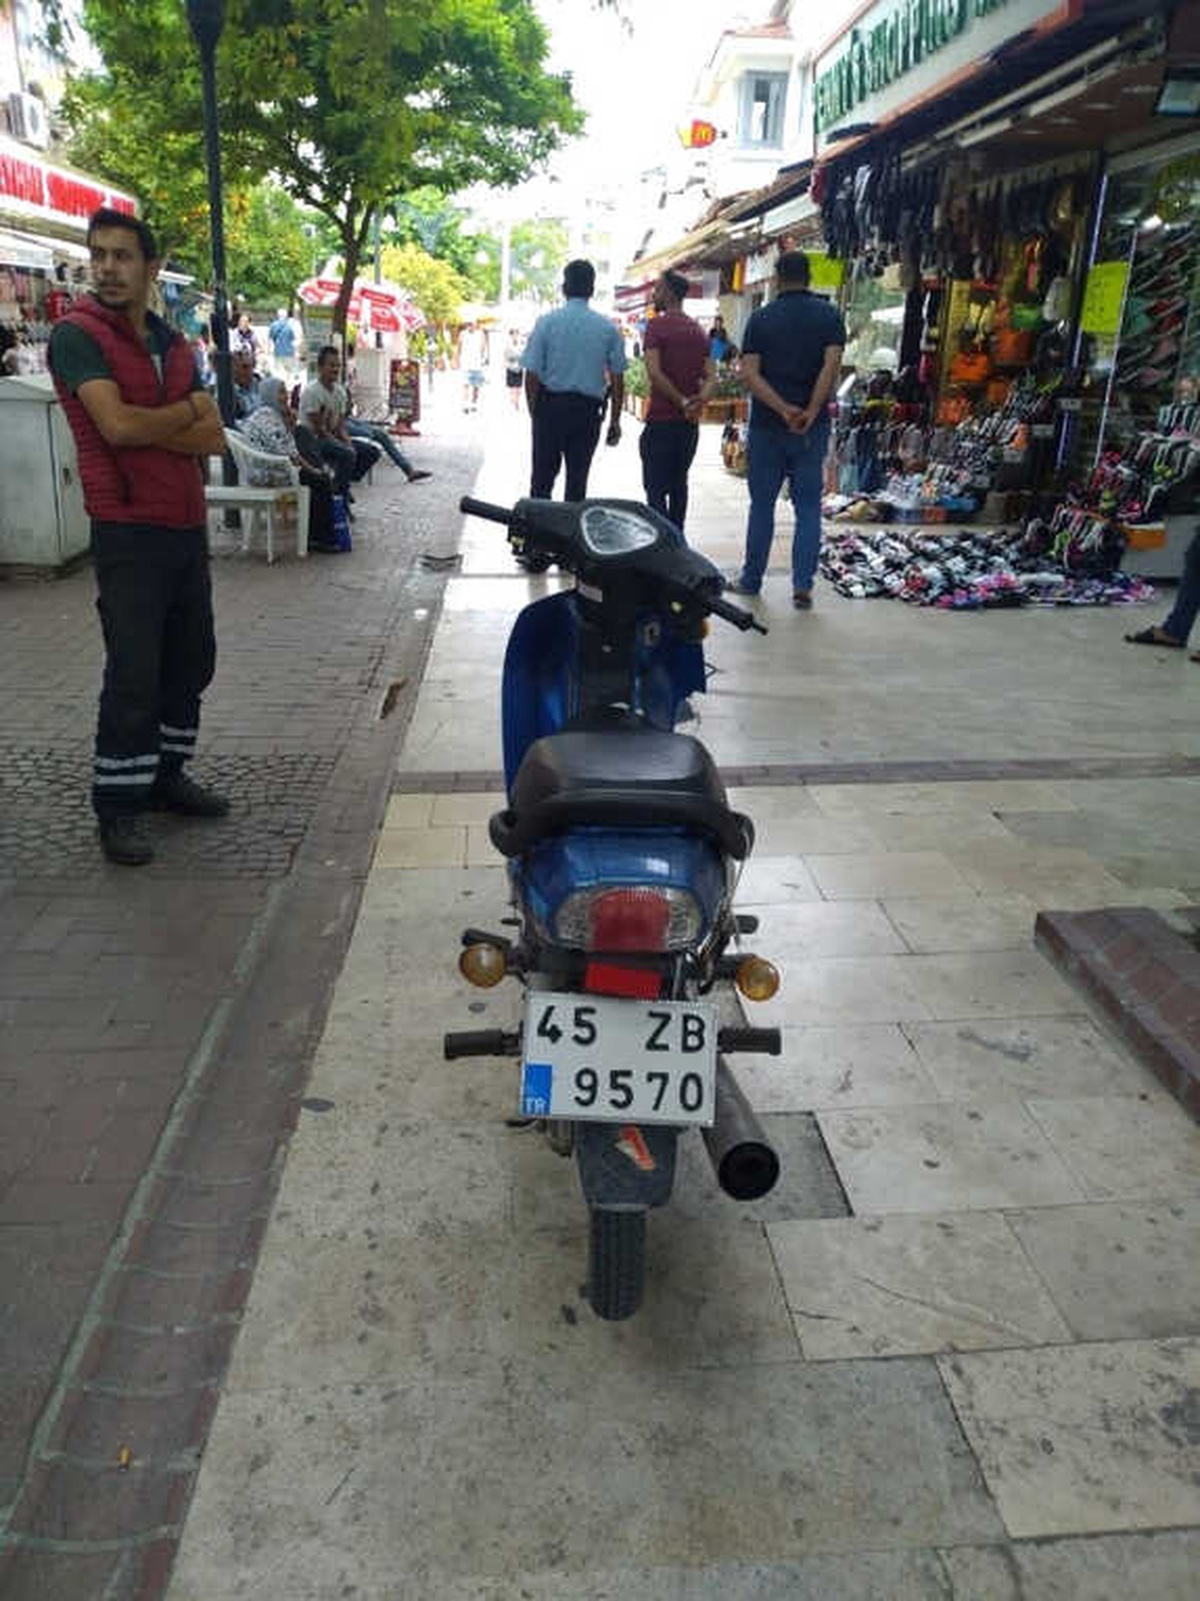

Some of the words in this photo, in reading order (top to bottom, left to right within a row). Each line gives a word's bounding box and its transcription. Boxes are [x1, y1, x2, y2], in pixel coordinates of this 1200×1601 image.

[537, 1005, 597, 1046] 45
[645, 1009, 706, 1054] ZB
[525, 1097, 547, 1114] TR
[573, 1067, 704, 1112] 9570
